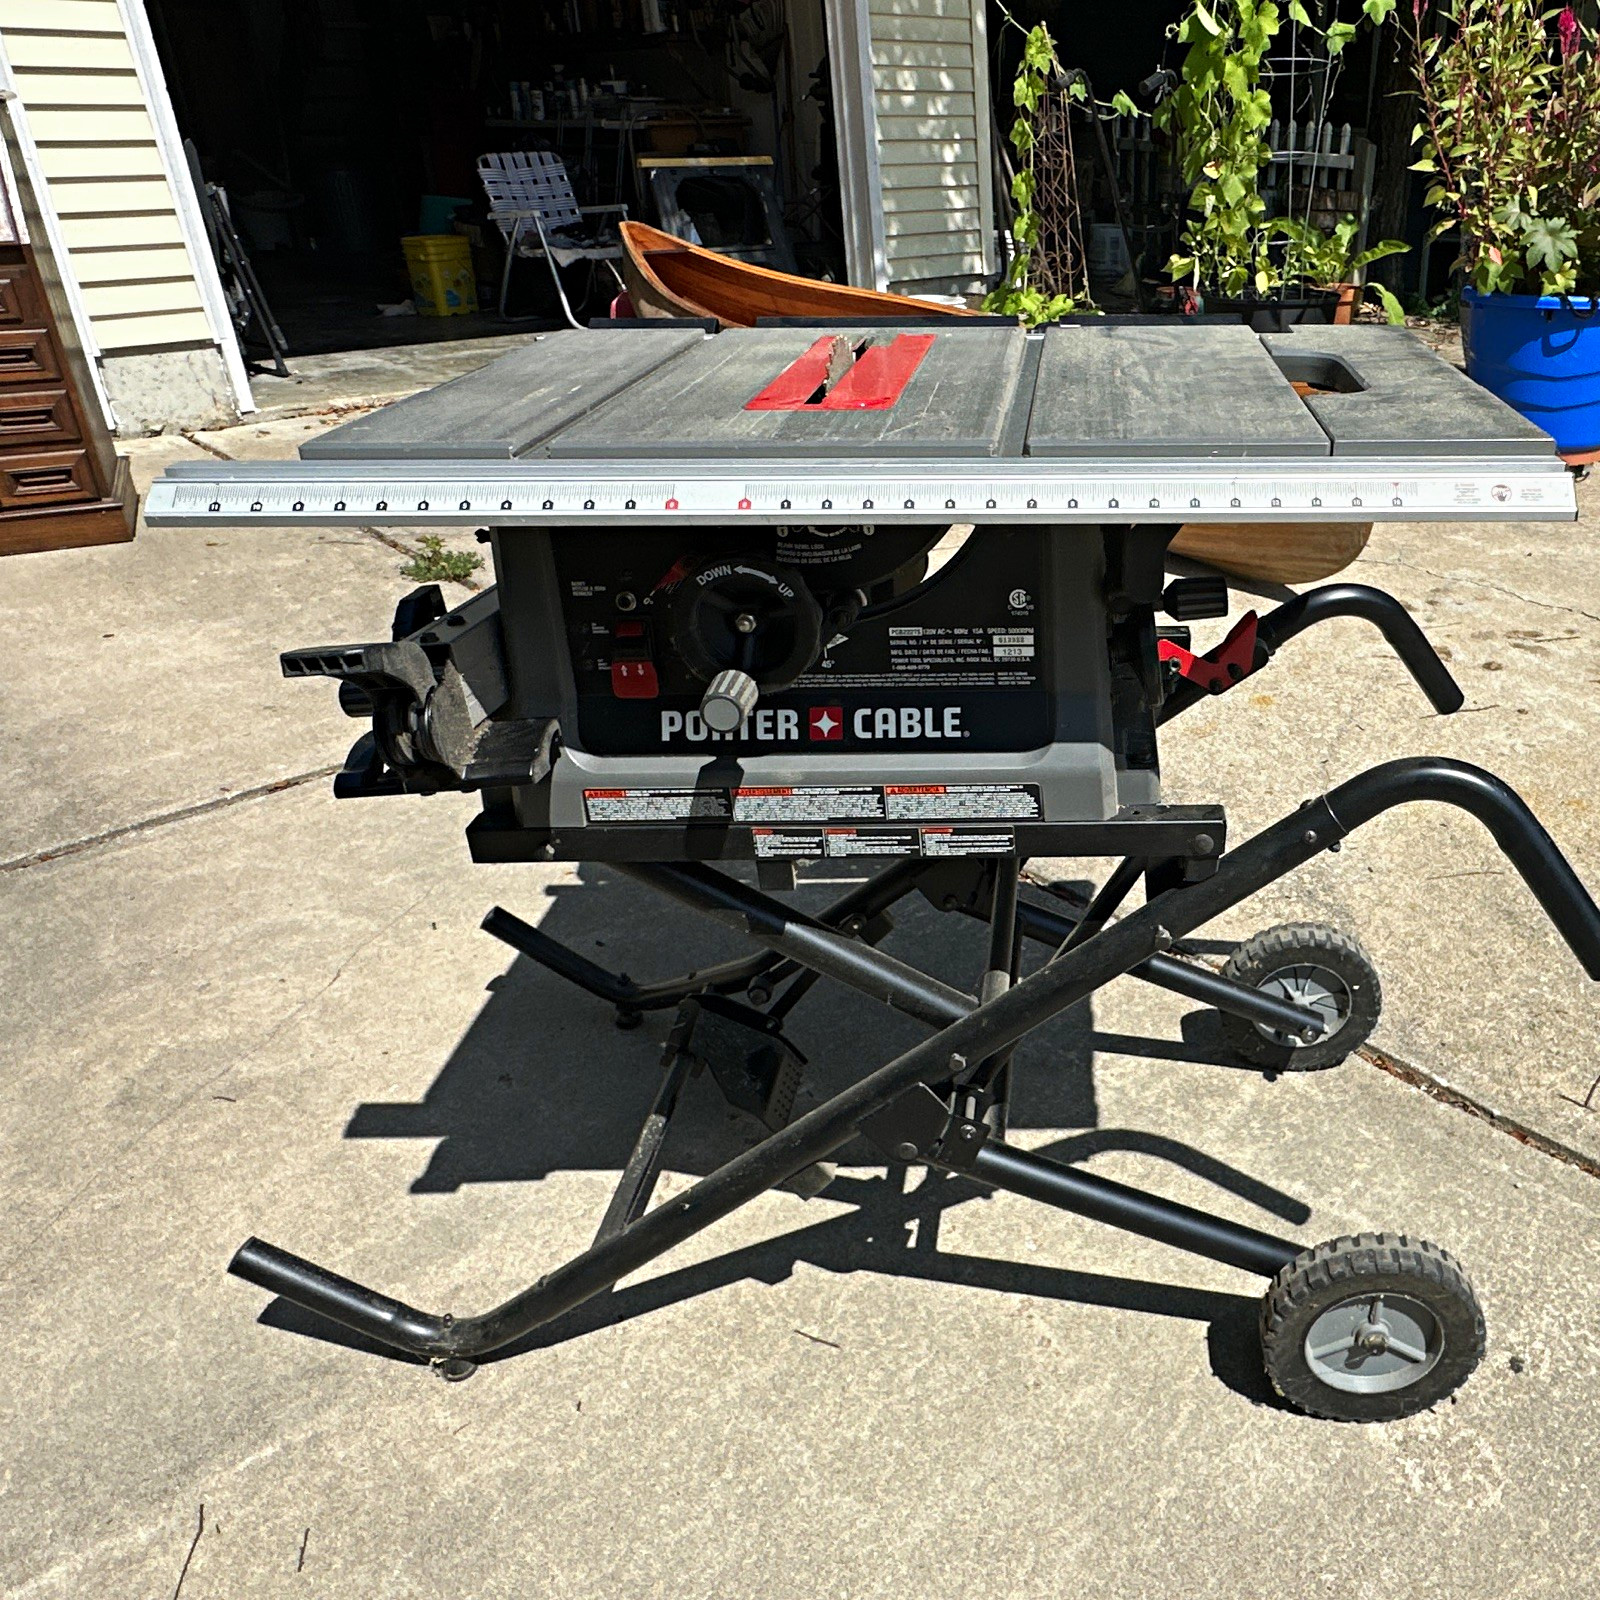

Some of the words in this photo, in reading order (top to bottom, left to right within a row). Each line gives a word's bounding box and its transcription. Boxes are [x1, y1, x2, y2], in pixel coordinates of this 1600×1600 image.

[696, 564, 732, 586] DOWN
[778, 582, 794, 598] UP
[821, 660, 835, 669] 45°
[661, 710, 799, 741] POTER
[854, 707, 962, 739] CABLE
